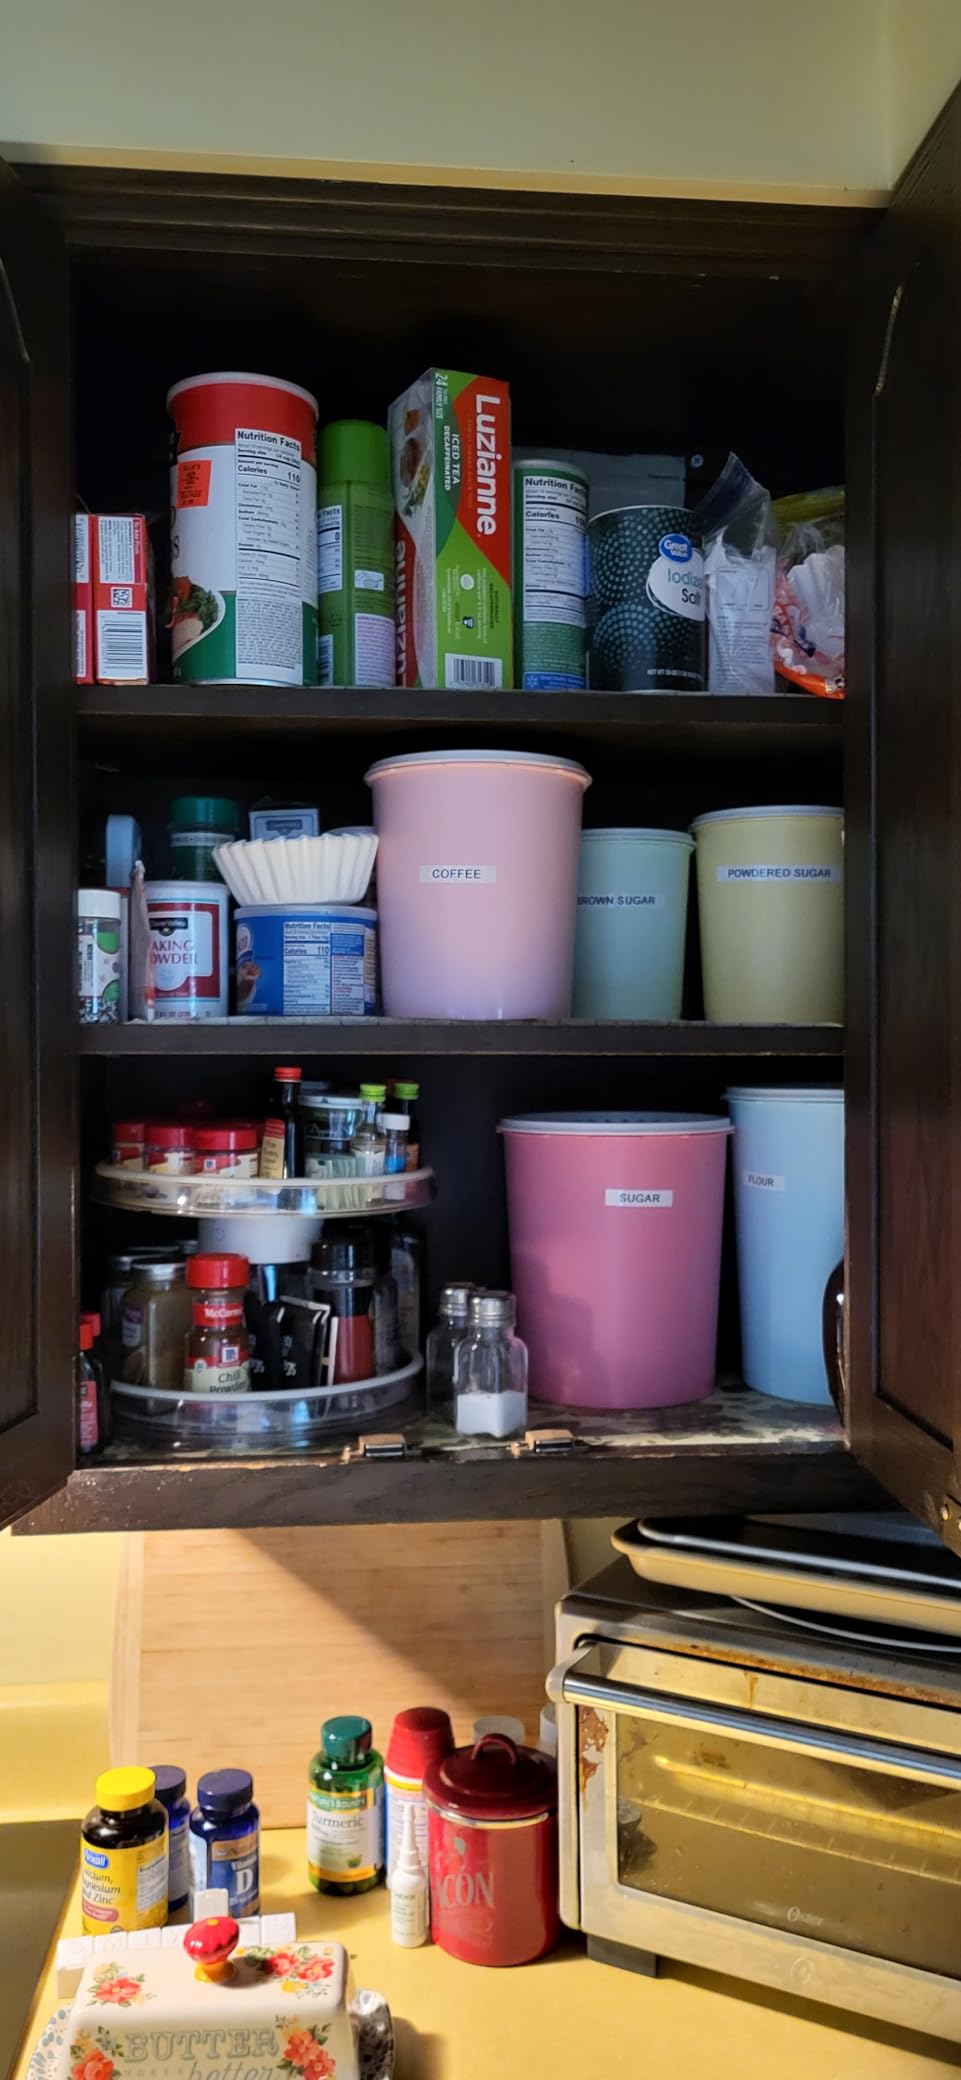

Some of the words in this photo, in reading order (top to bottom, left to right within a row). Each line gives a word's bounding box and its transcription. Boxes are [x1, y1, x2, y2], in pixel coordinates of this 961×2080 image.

[435, 372, 449, 387] 24
[237, 430, 278, 446] Nutrition
[280, 437, 300, 452] Facts
[452, 433, 460, 460] ICED
[443, 425, 451, 491] DECAFFEINATED
[476, 394, 502, 535] Luzianne
[238, 465, 268, 475] Calories
[288, 471, 301, 484] 110
[452, 464, 460, 485] TEA
[525, 478, 568, 491] Nutrition
[525, 511, 560, 520] Calories
[432, 868, 481, 880] COFFEE
[728, 868, 791, 879] POWDERED
[793, 867, 832, 879] SUGAR
[576, 895, 615, 906] BROWN
[617, 895, 656, 906] SUGAR
[151, 940, 195, 952] AKING
[317, 945, 330, 955] 110
[748, 1174, 775, 1188] FLOUR
[620, 1192, 661, 1204] SUGAR
[236, 1868, 254, 1894] D
[124, 2028, 281, 2064] BUTTER
